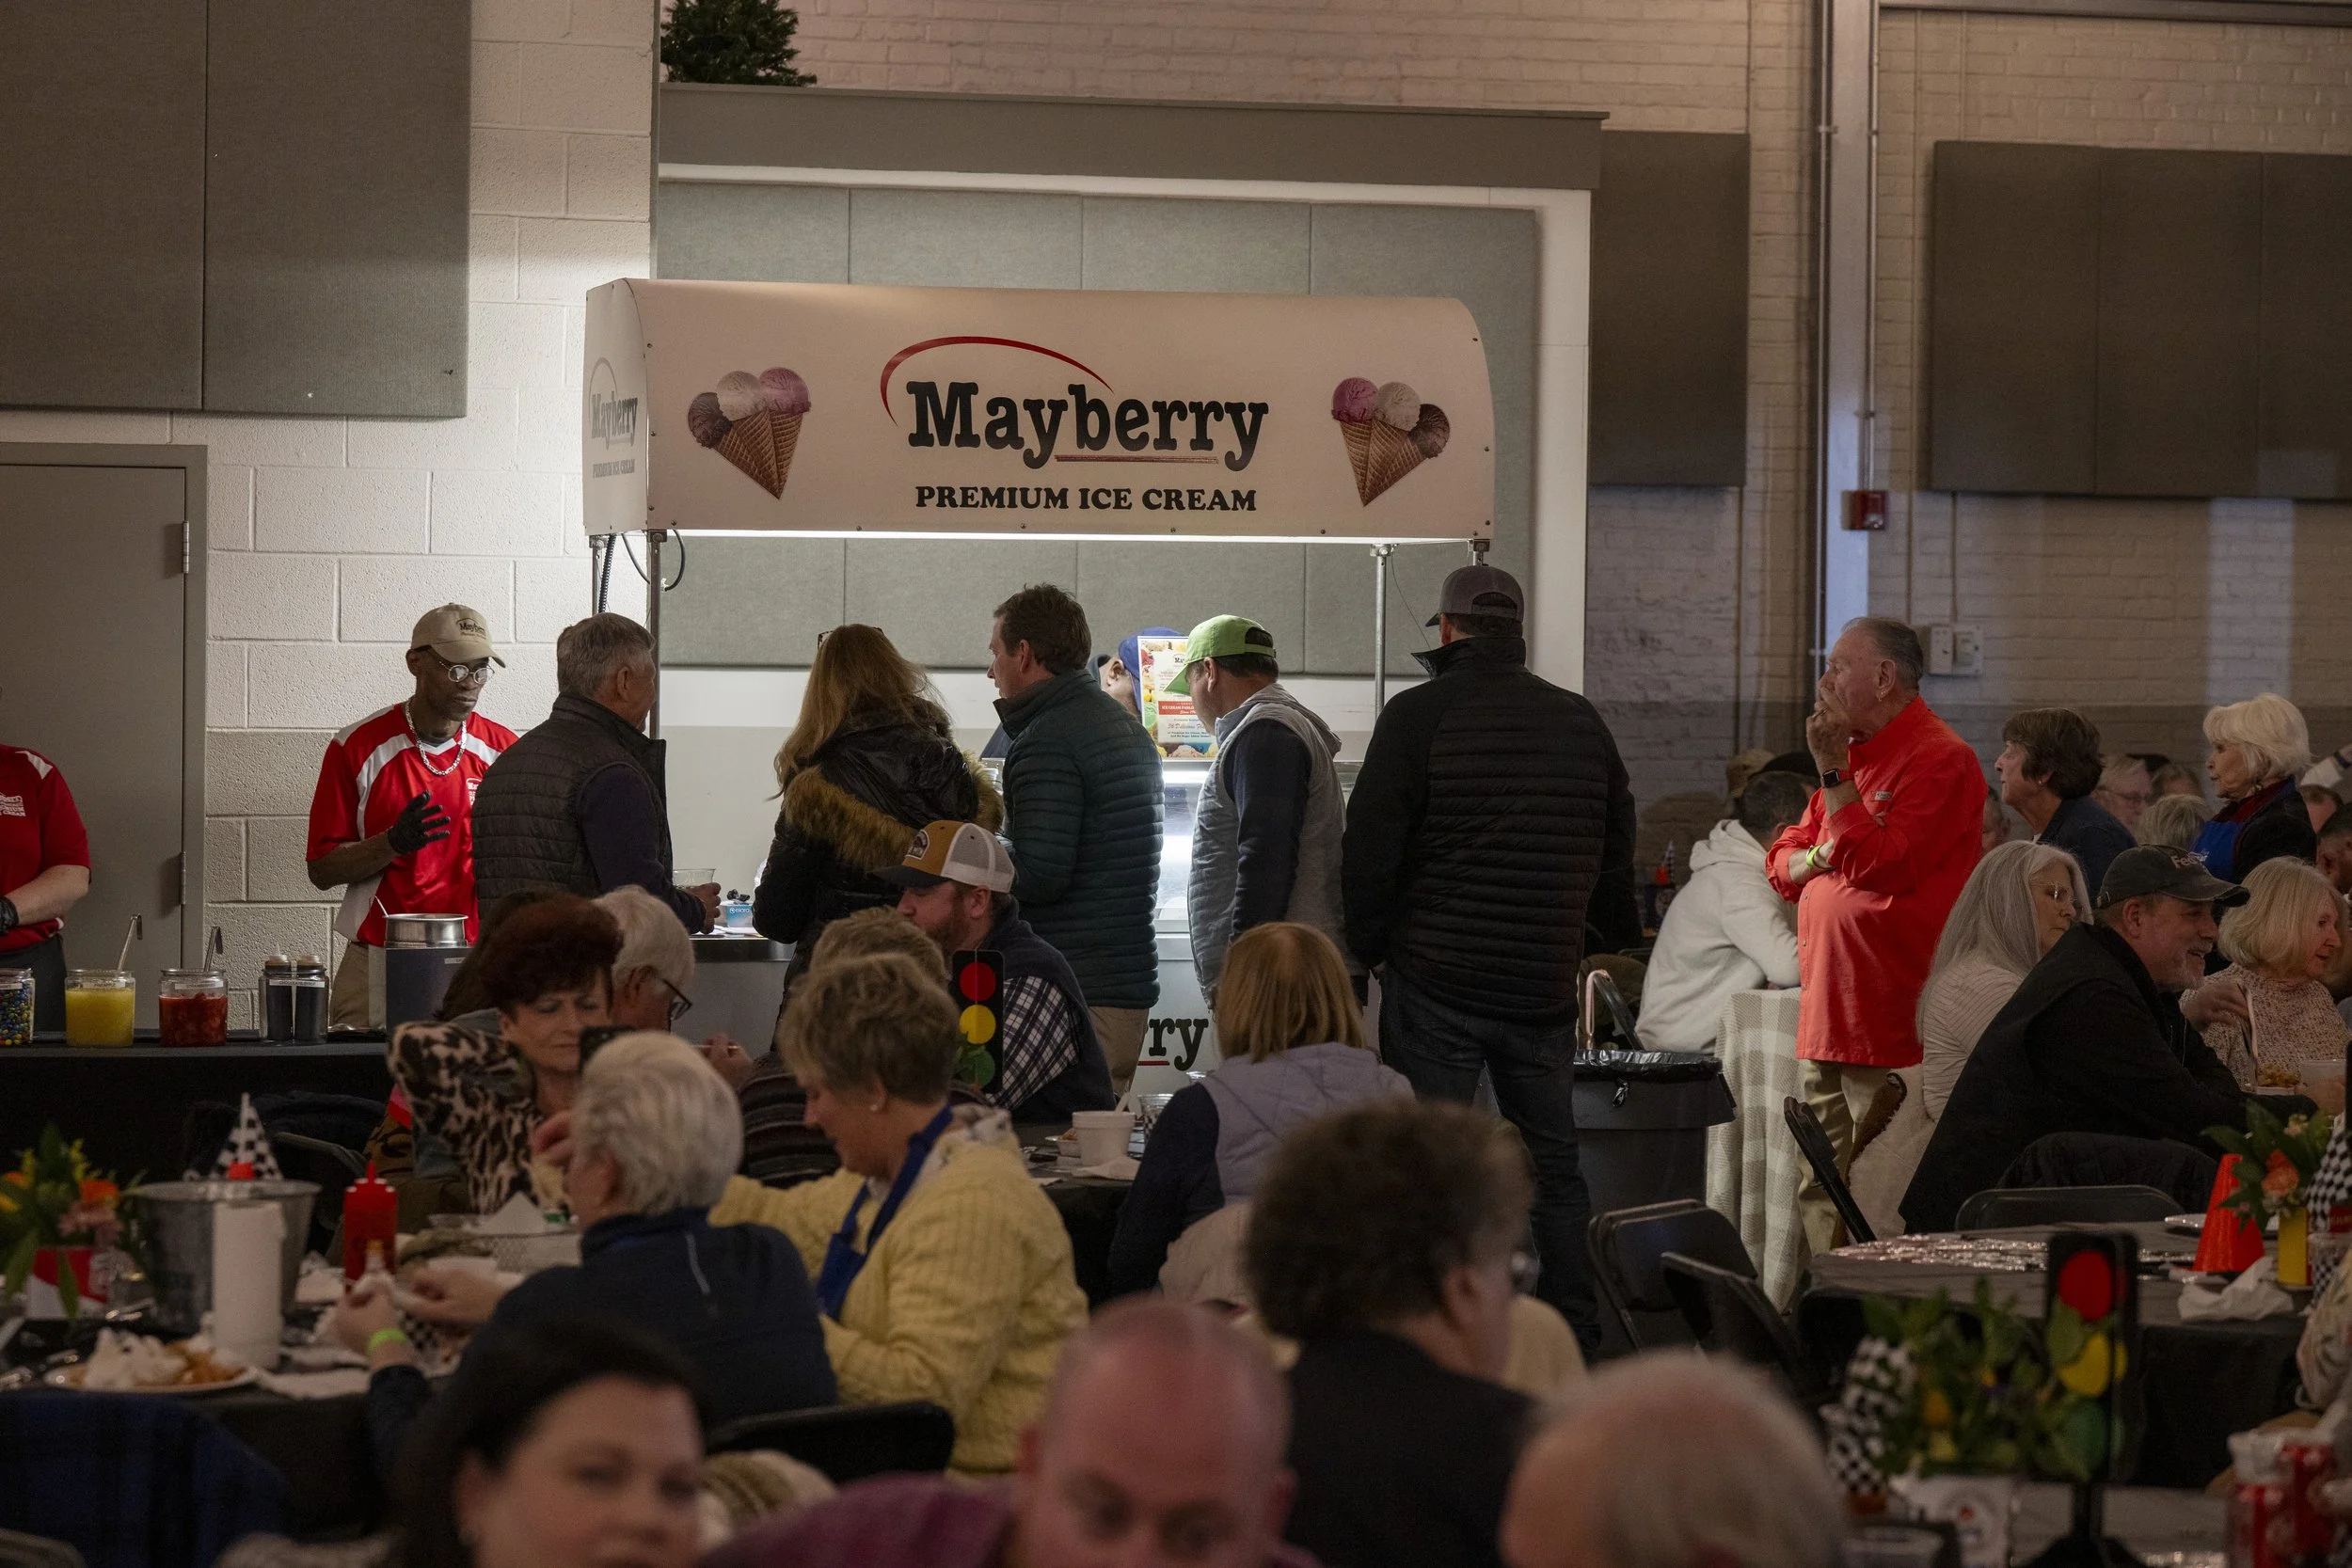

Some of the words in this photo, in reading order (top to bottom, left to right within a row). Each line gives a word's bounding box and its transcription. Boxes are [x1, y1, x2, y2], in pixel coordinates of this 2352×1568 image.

[591, 391, 639, 451] Mayberry
[905, 381, 1269, 472] Mayberry
[914, 485, 1070, 510] PREMIUM
[1078, 487, 1133, 511] ICE
[1141, 488, 1257, 512] CREAM
[1146, 1017, 1209, 1071] ry
